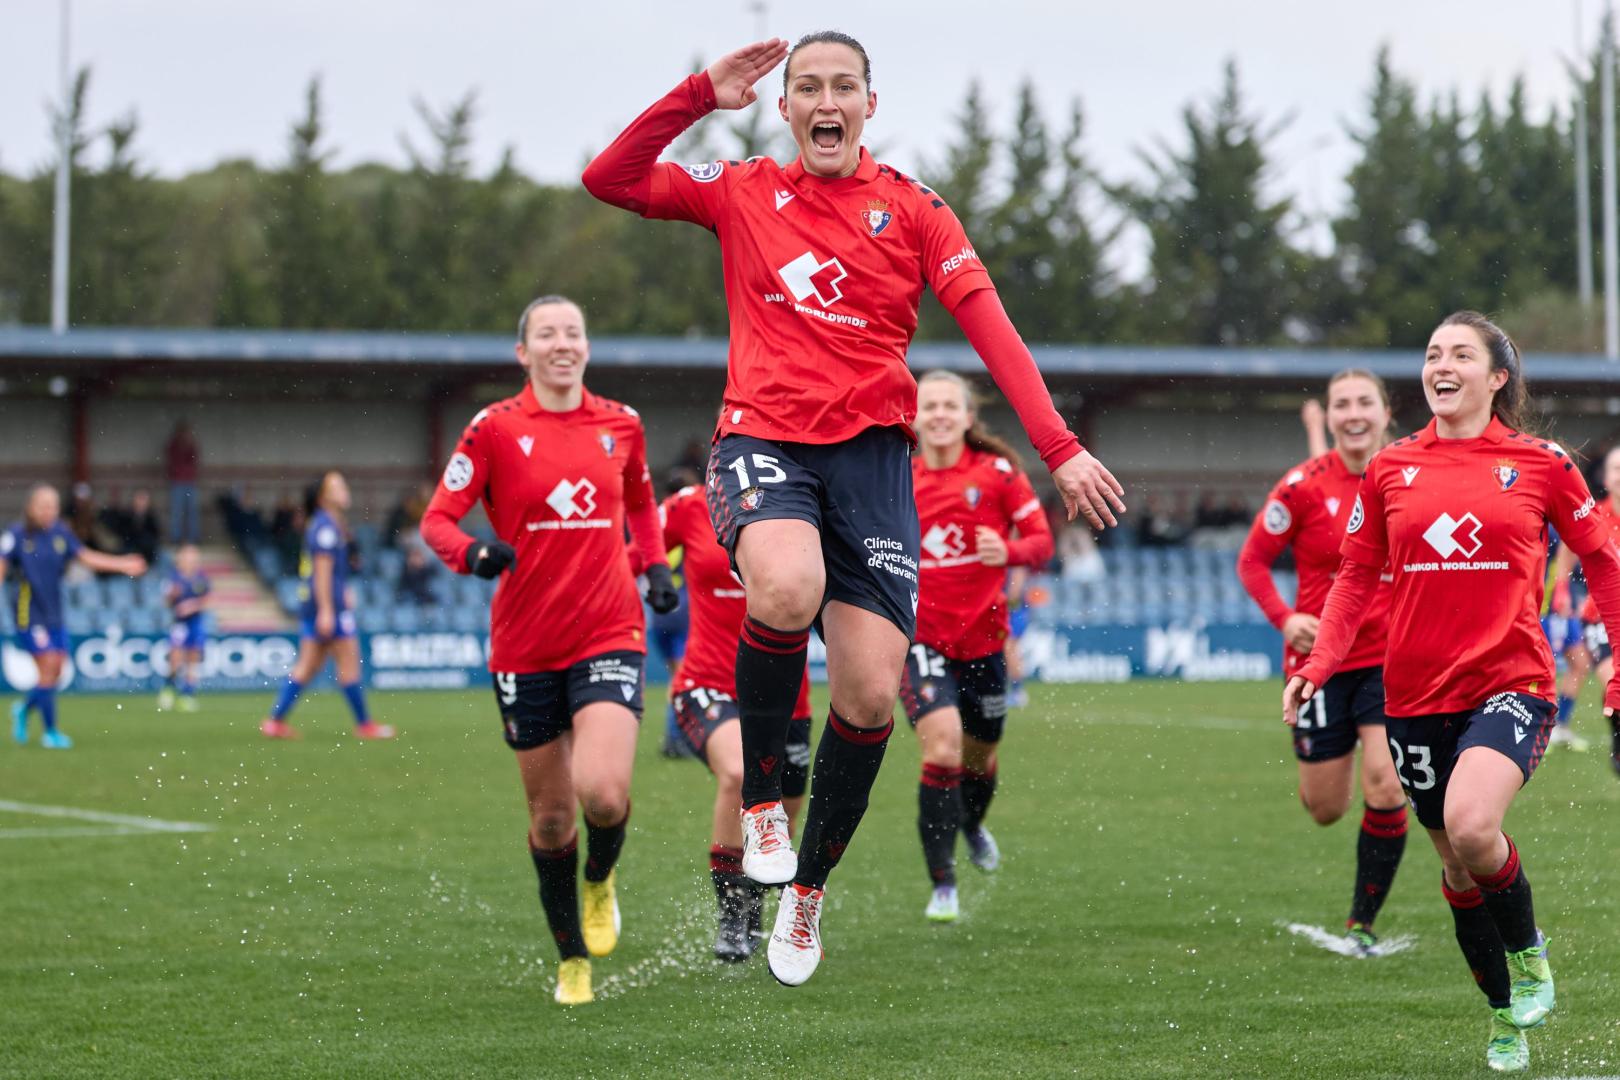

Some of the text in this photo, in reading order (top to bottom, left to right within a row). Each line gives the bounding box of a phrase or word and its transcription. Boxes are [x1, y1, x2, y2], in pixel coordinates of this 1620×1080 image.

[794, 303, 868, 328] WORLDWIDE
[728, 453, 787, 491] 15
[863, 537, 903, 551] Clínica
[867, 557, 882, 568] de
[869, 550, 918, 572] niversidad
[1403, 561, 1509, 573] BAIKOR WORLDWIDE
[911, 643, 946, 677] 12
[1390, 737, 1436, 790] 23
